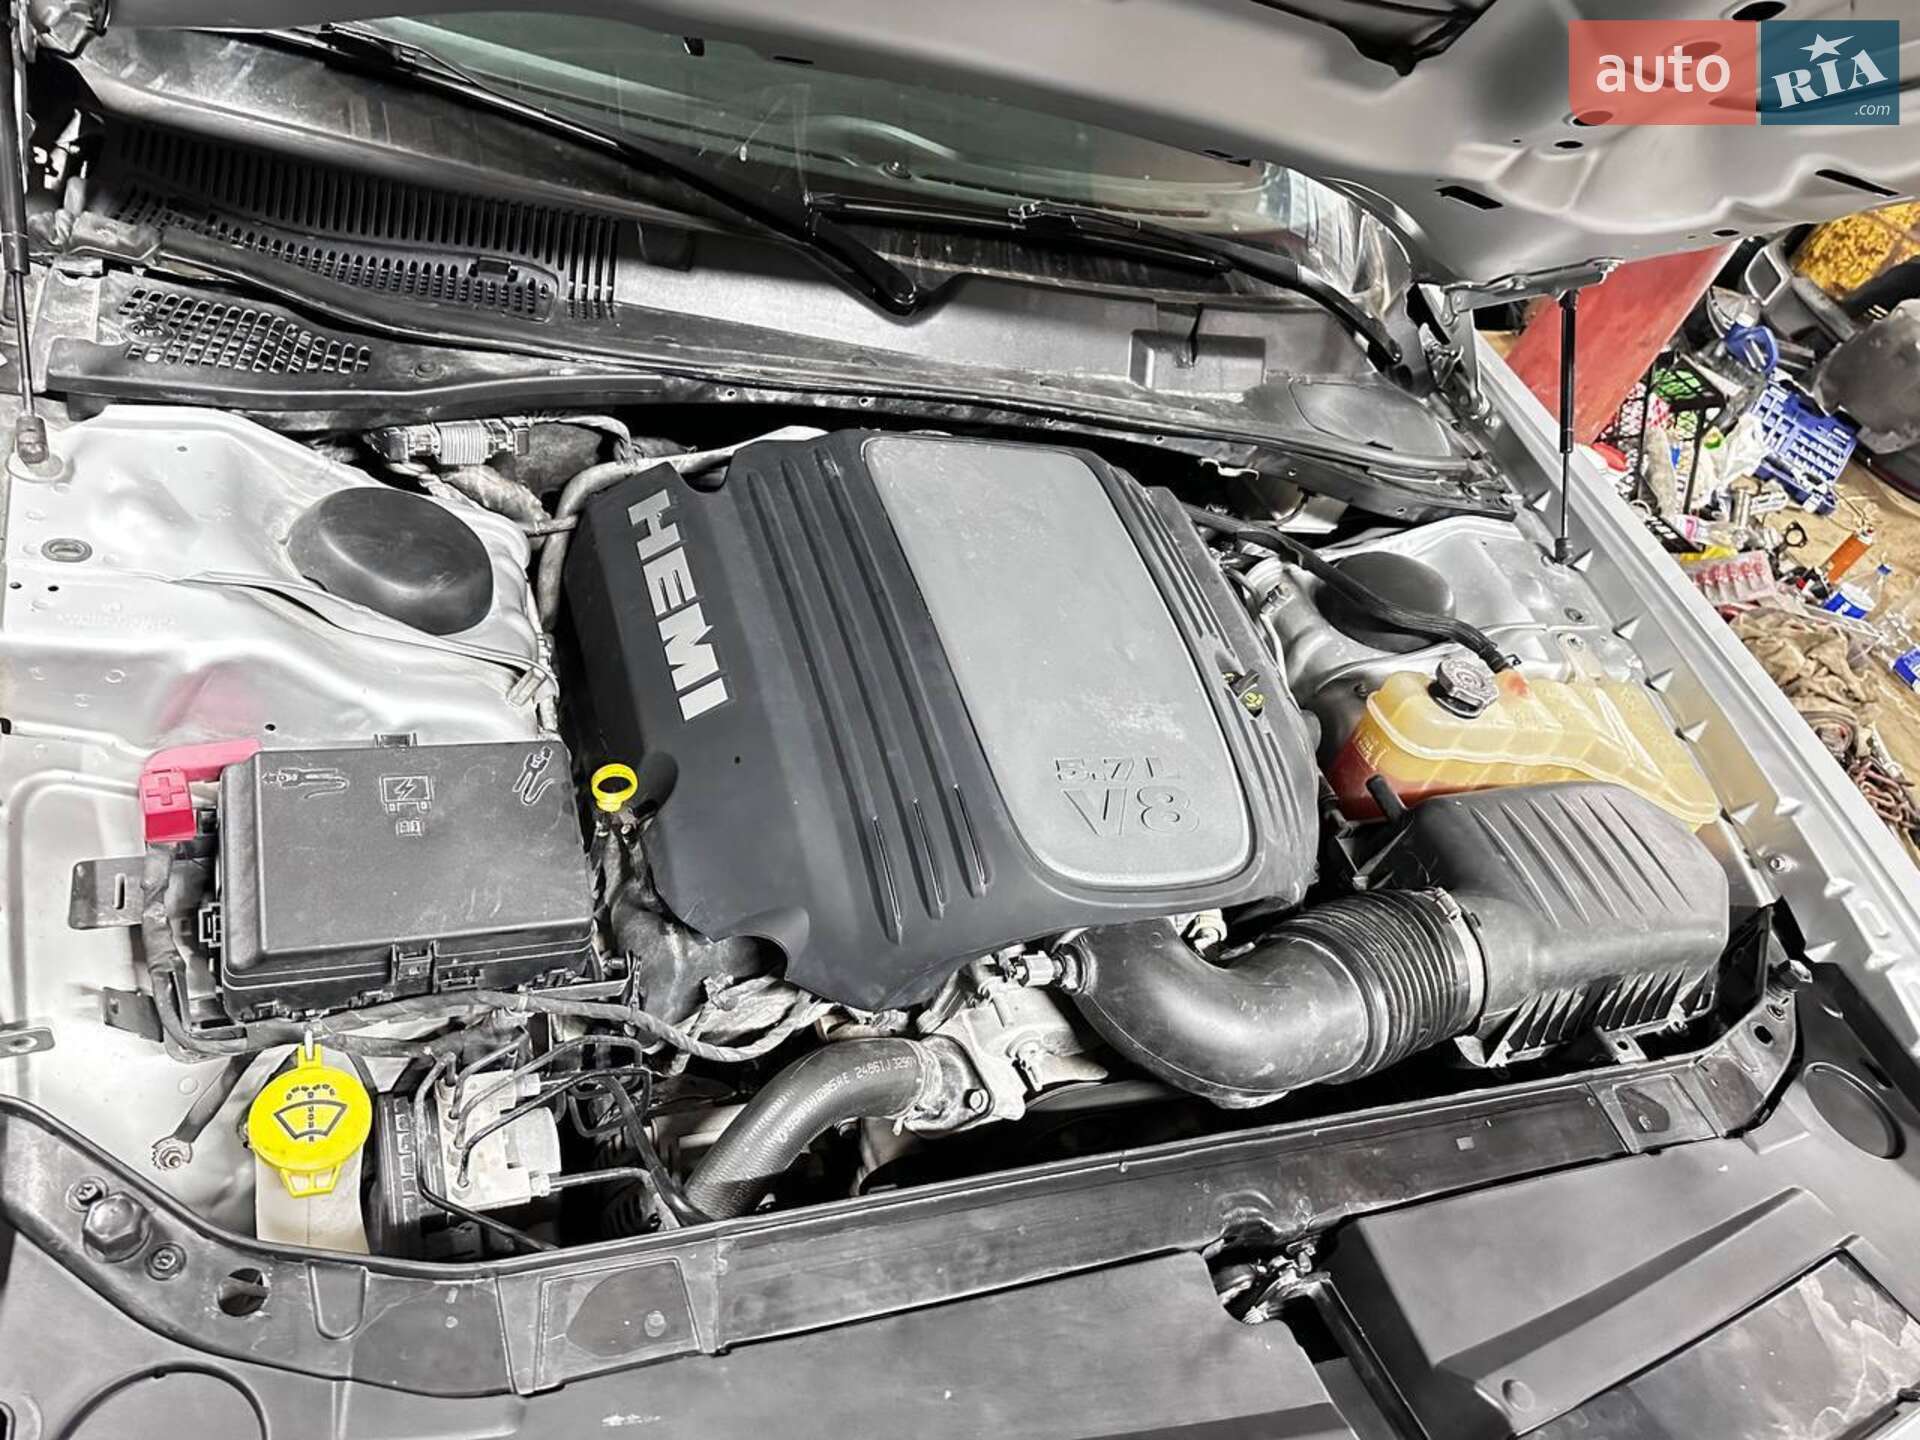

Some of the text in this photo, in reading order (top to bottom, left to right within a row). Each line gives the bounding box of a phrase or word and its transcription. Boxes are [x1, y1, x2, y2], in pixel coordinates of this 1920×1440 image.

[627, 489, 729, 721] HEMI
[1054, 756, 1181, 781] 5.7L
[1060, 785, 1201, 837] V8
